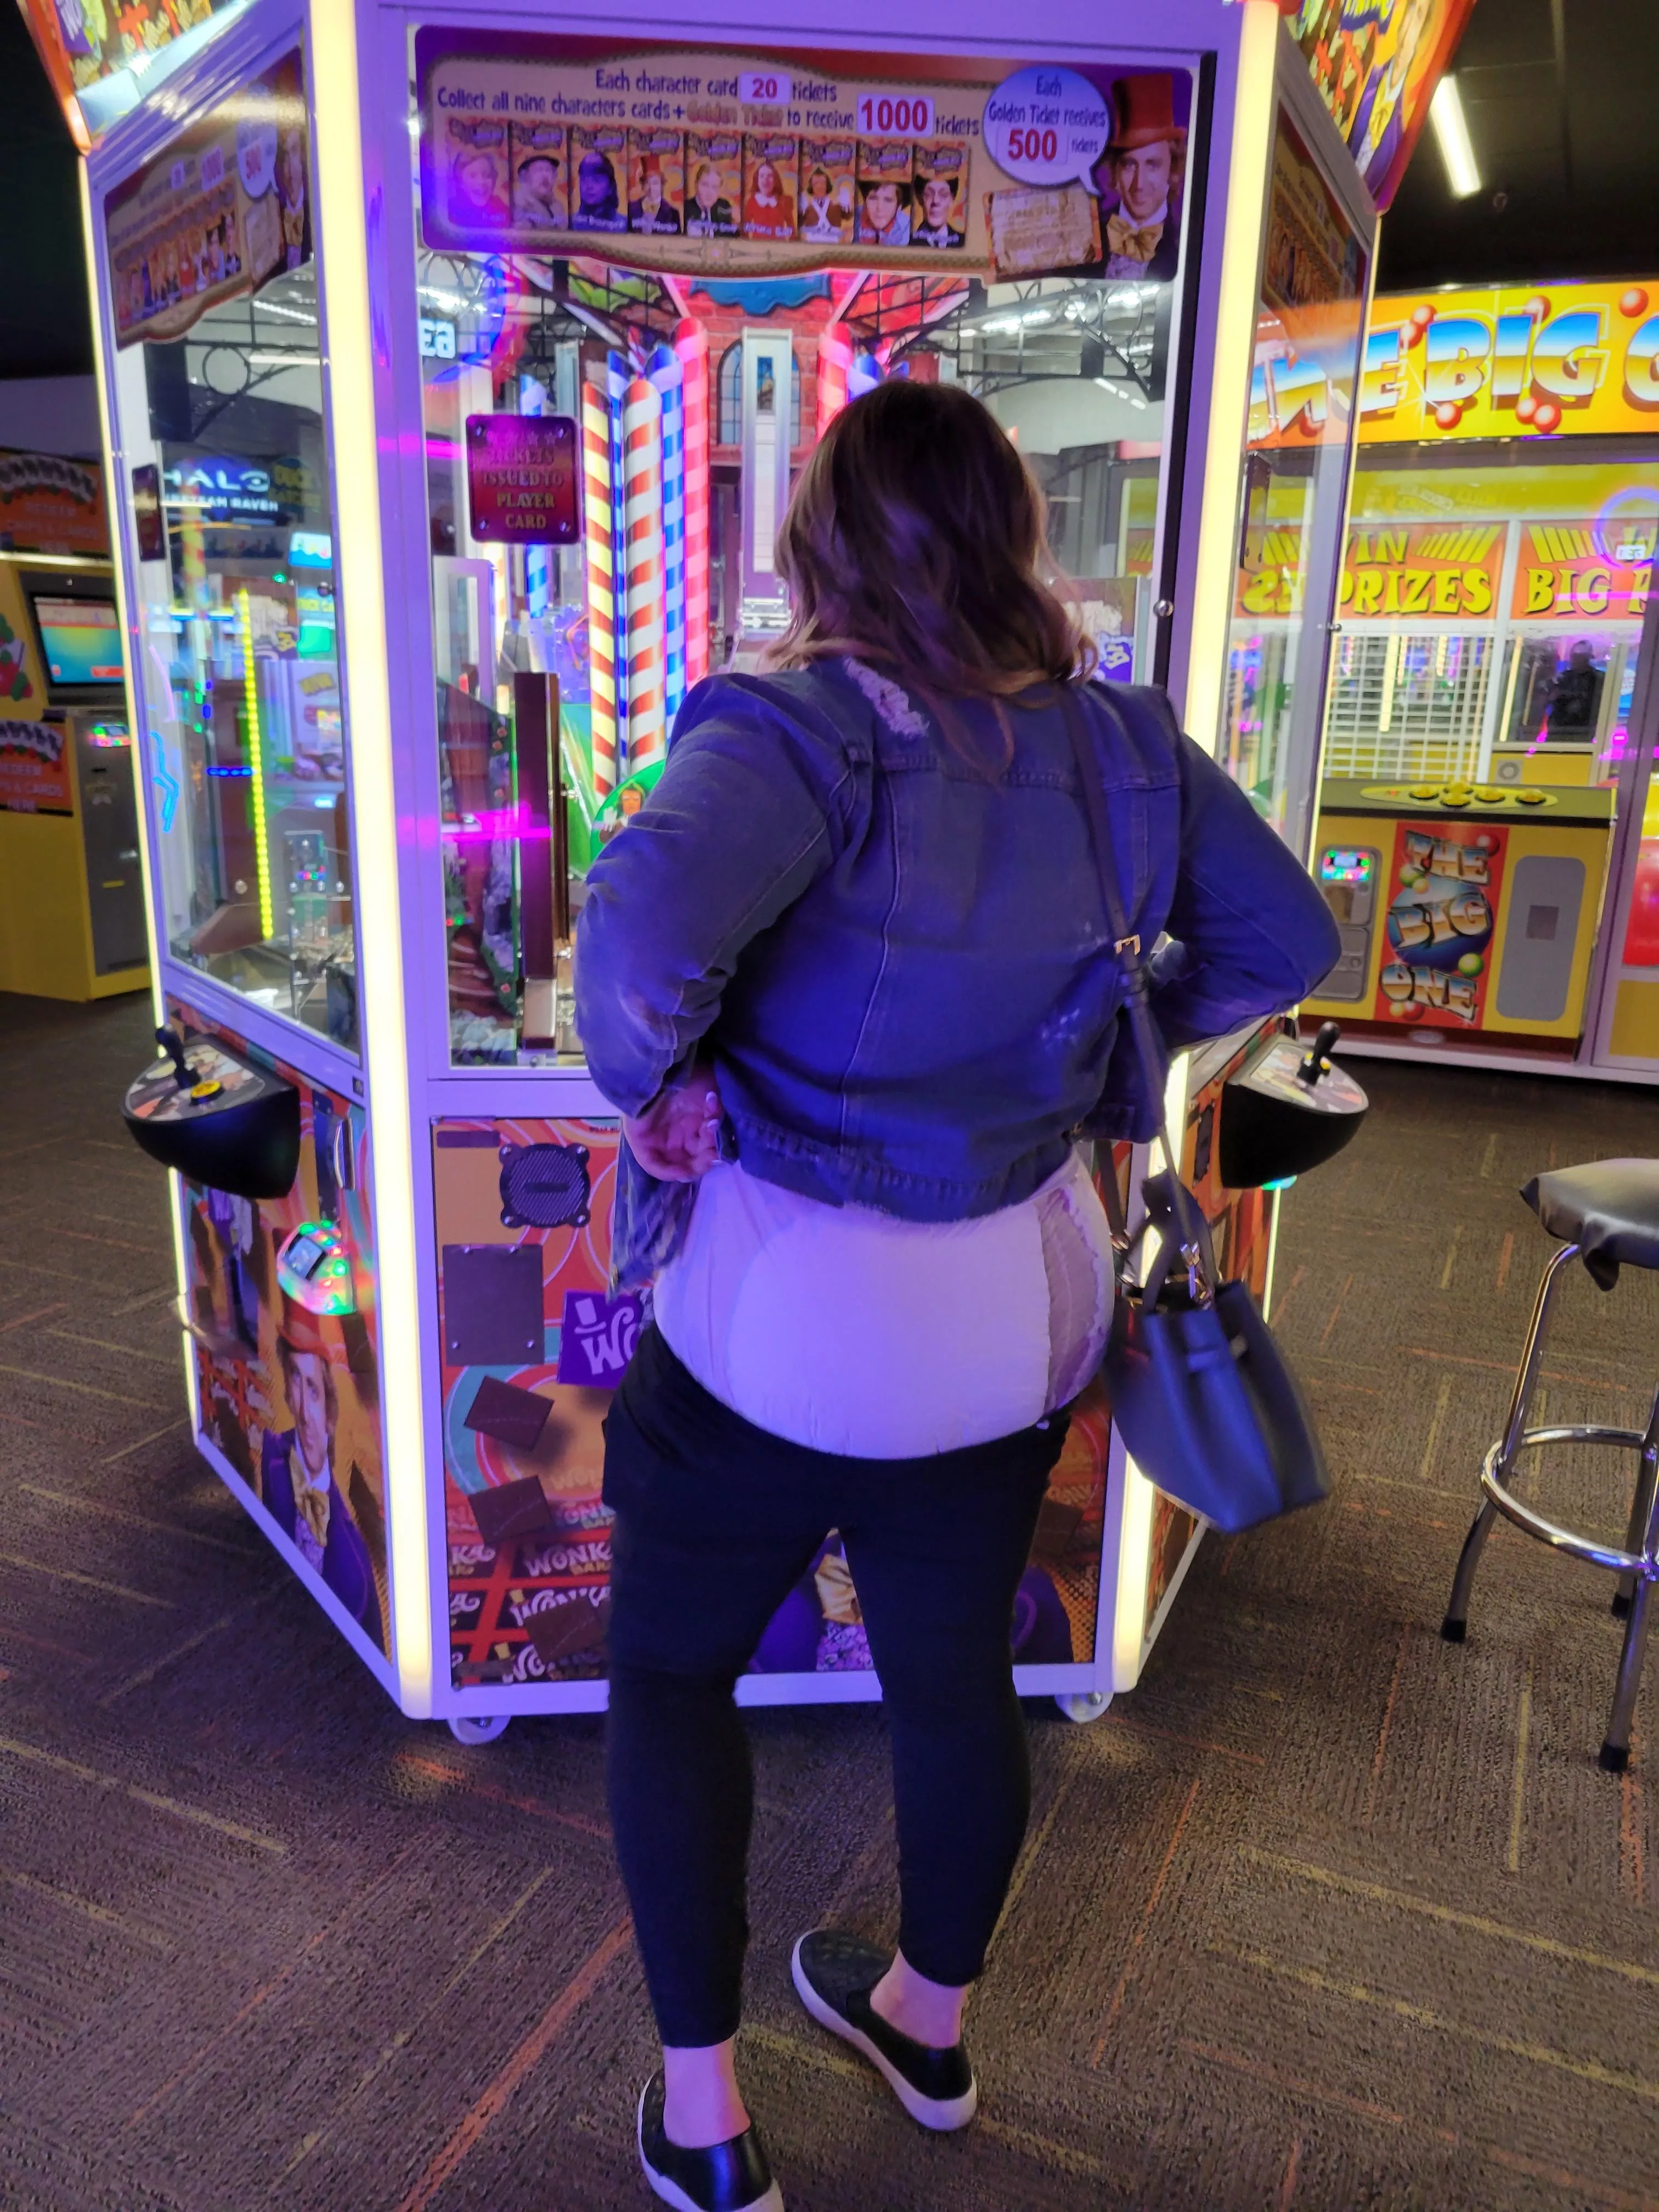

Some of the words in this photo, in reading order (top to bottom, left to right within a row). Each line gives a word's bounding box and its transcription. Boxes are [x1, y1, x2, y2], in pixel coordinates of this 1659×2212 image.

[596, 68, 630, 92] Each
[635, 69, 702, 95] character
[707, 76, 740, 98] card
[752, 77, 778, 99] 20
[792, 80, 837, 103] tickets
[1036, 75, 1062, 98] Each
[437, 86, 486, 109] Collect
[492, 90, 509, 111] all
[515, 93, 546, 114] nine
[551, 92, 625, 117] characters
[631, 100, 670, 120] cards
[787, 106, 801, 127] to
[806, 110, 854, 131] receive
[860, 98, 928, 133] 1000
[934, 114, 980, 138] tickets
[989, 100, 1026, 123] Golden
[1030, 104, 1060, 126] Ticket
[1008, 129, 1058, 162] 500
[1426, 311, 1604, 403] BIG
[483, 468, 540, 486] ISSUED
[542, 471, 563, 486] TO
[496, 492, 555, 508] PLAYER
[505, 514, 546, 529] CARD
[1346, 528, 1409, 566] IN
[1524, 567, 1612, 616] BIG
[1406, 830, 1491, 886] THE
[1389, 891, 1491, 949] BIG
[1380, 963, 1477, 1021] ONE
